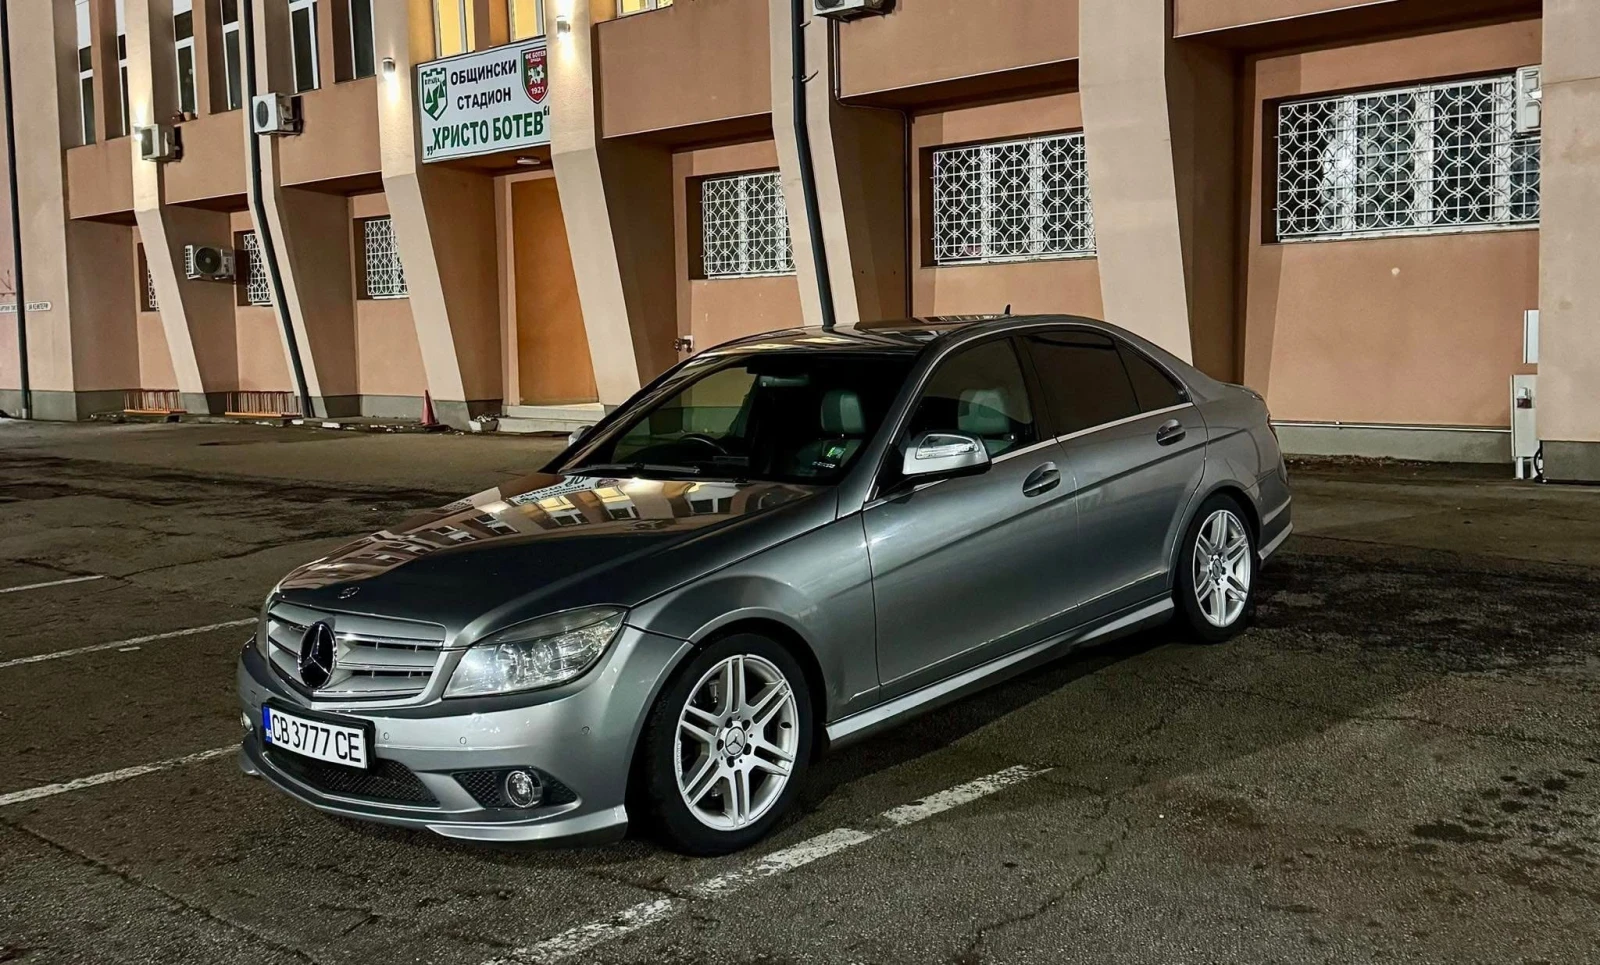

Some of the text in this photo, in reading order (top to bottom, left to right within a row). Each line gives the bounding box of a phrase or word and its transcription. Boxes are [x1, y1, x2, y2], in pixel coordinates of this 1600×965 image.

[450, 59, 517, 86] ОБЩИНСКИ
[457, 87, 511, 110] СТАДИОН
[531, 86, 544, 95] 1921
[272, 714, 362, 763] CB 3777 CE
